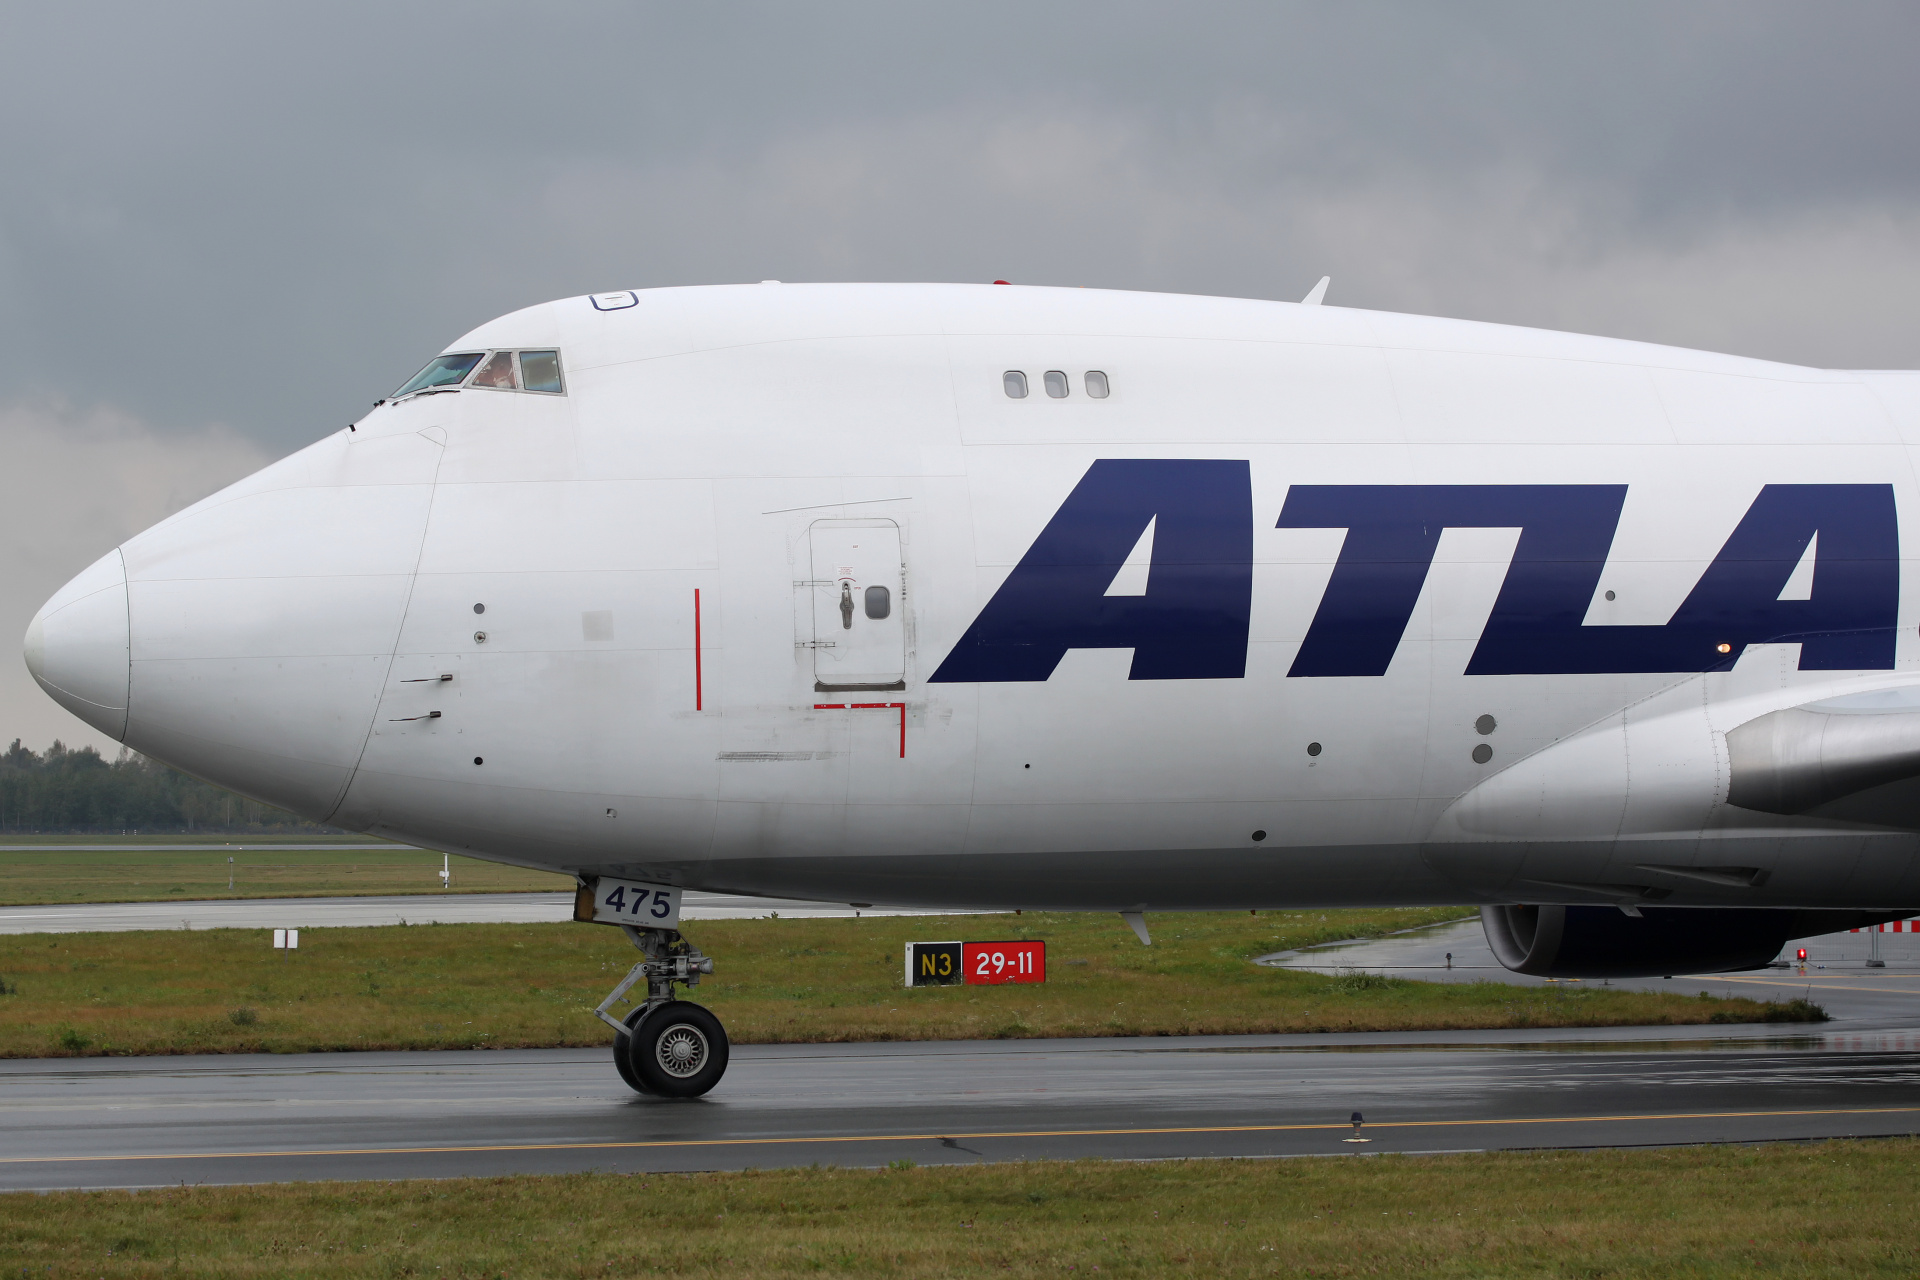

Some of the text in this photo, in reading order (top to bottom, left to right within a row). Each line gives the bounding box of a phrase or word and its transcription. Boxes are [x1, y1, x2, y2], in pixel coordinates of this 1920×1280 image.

[927, 458, 1920, 684] ATLA
[605, 886, 671, 918] 475
[922, 952, 952, 976] N3
[976, 951, 1032, 975] 29-11
